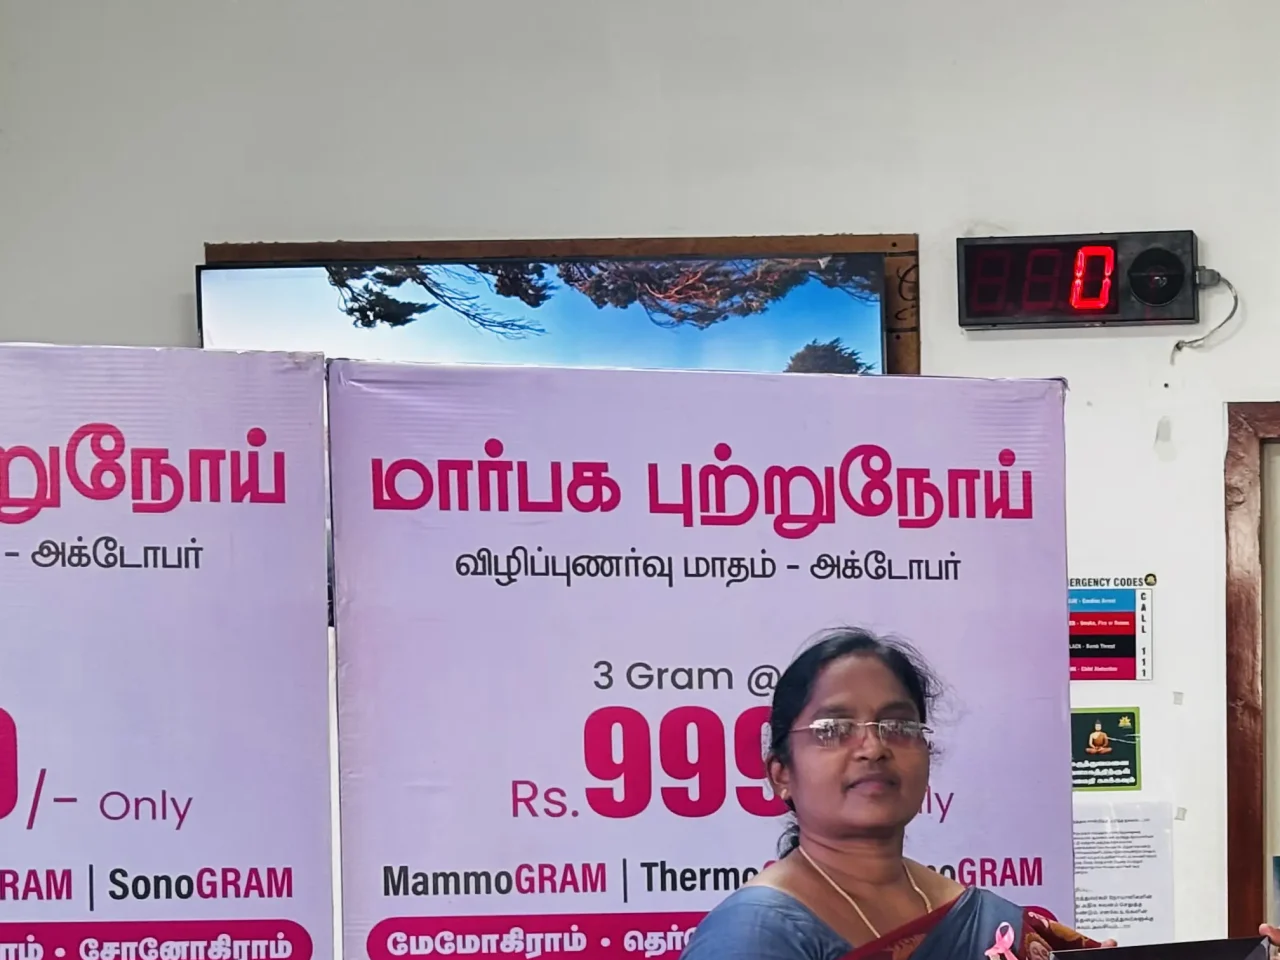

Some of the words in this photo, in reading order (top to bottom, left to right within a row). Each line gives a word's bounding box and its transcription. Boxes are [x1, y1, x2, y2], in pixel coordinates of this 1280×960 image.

[371, 438, 622, 513] மார்பக
[647, 442, 1033, 540] புற்றுநோய்
[31, 536, 205, 570] அக்டோபர்
[455, 545, 674, 587] விழிப்புணர்வு
[684, 548, 777, 587] மாதம்
[810, 549, 962, 582] அக்டோபர்
[1113, 577, 1144, 587] CODES
[593, 661, 614, 692] 3
[626, 660, 734, 691] Gram
[99, 789, 193, 831] Only
[511, 781, 579, 818] Rs.
[108, 867, 293, 901] SonoGRAM
[383, 862, 607, 897] MammoGRAM
[643, 858, 780, 893] Thermo
[387, 925, 586, 959] மேமோகிராம்
